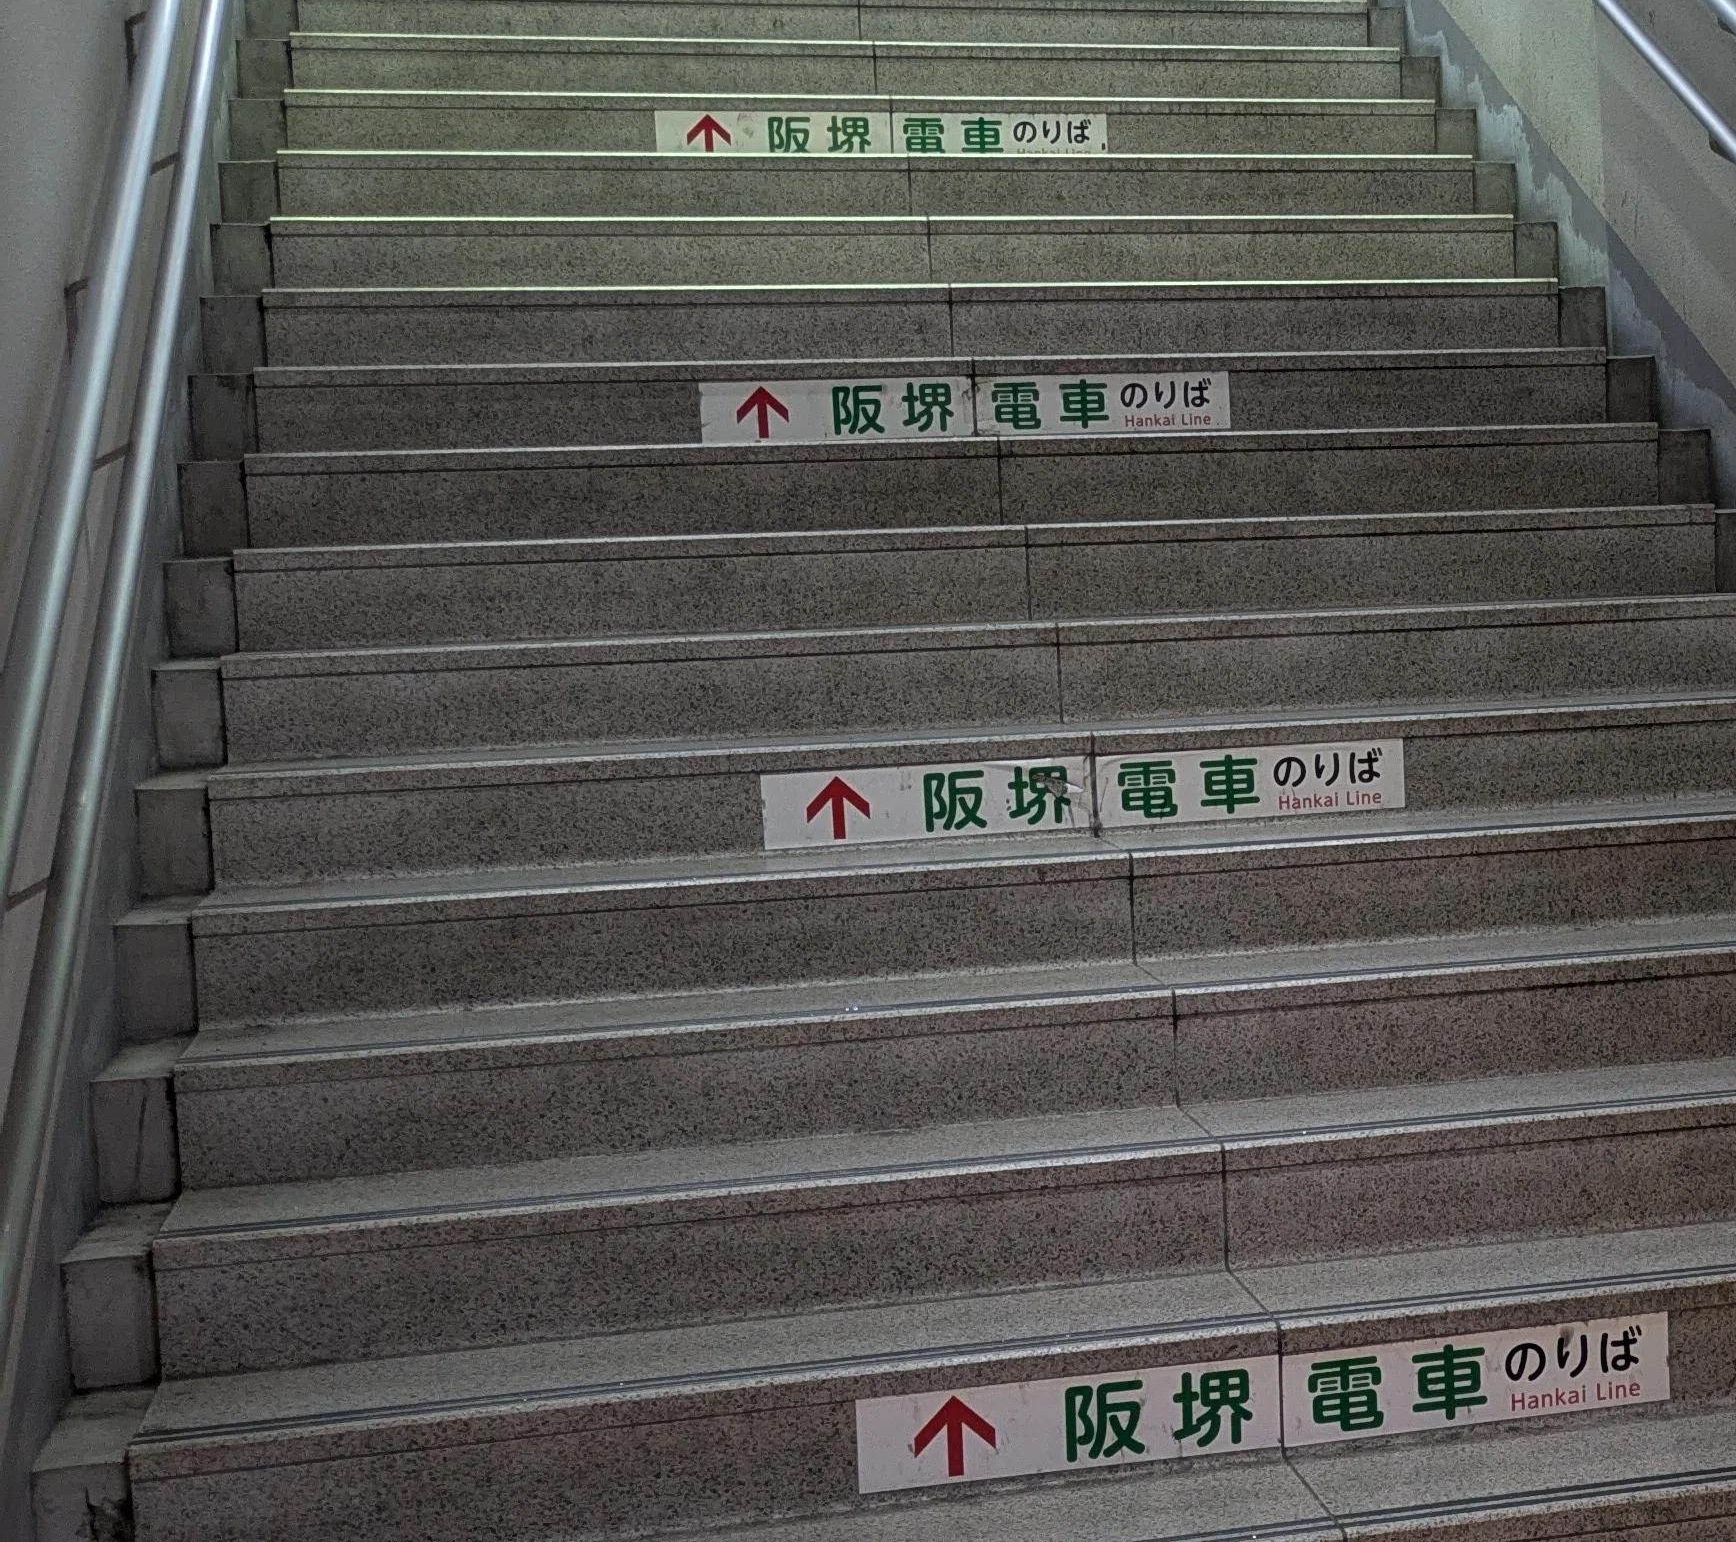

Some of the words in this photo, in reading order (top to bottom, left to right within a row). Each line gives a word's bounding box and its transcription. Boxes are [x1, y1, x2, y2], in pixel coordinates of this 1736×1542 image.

[831, 377, 1212, 435] 阪堺電車のりば
[1124, 414, 1176, 428] Hankai
[1181, 413, 1212, 426] Line
[923, 747, 1383, 833] 阪堺電車のりば
[1278, 792, 1339, 811] Hankai
[1346, 790, 1382, 806] Line
[1065, 1325, 1643, 1463] 阪堺電車のりば
[1511, 1385, 1587, 1411] Hankai
[1596, 1381, 1641, 1401] Line
